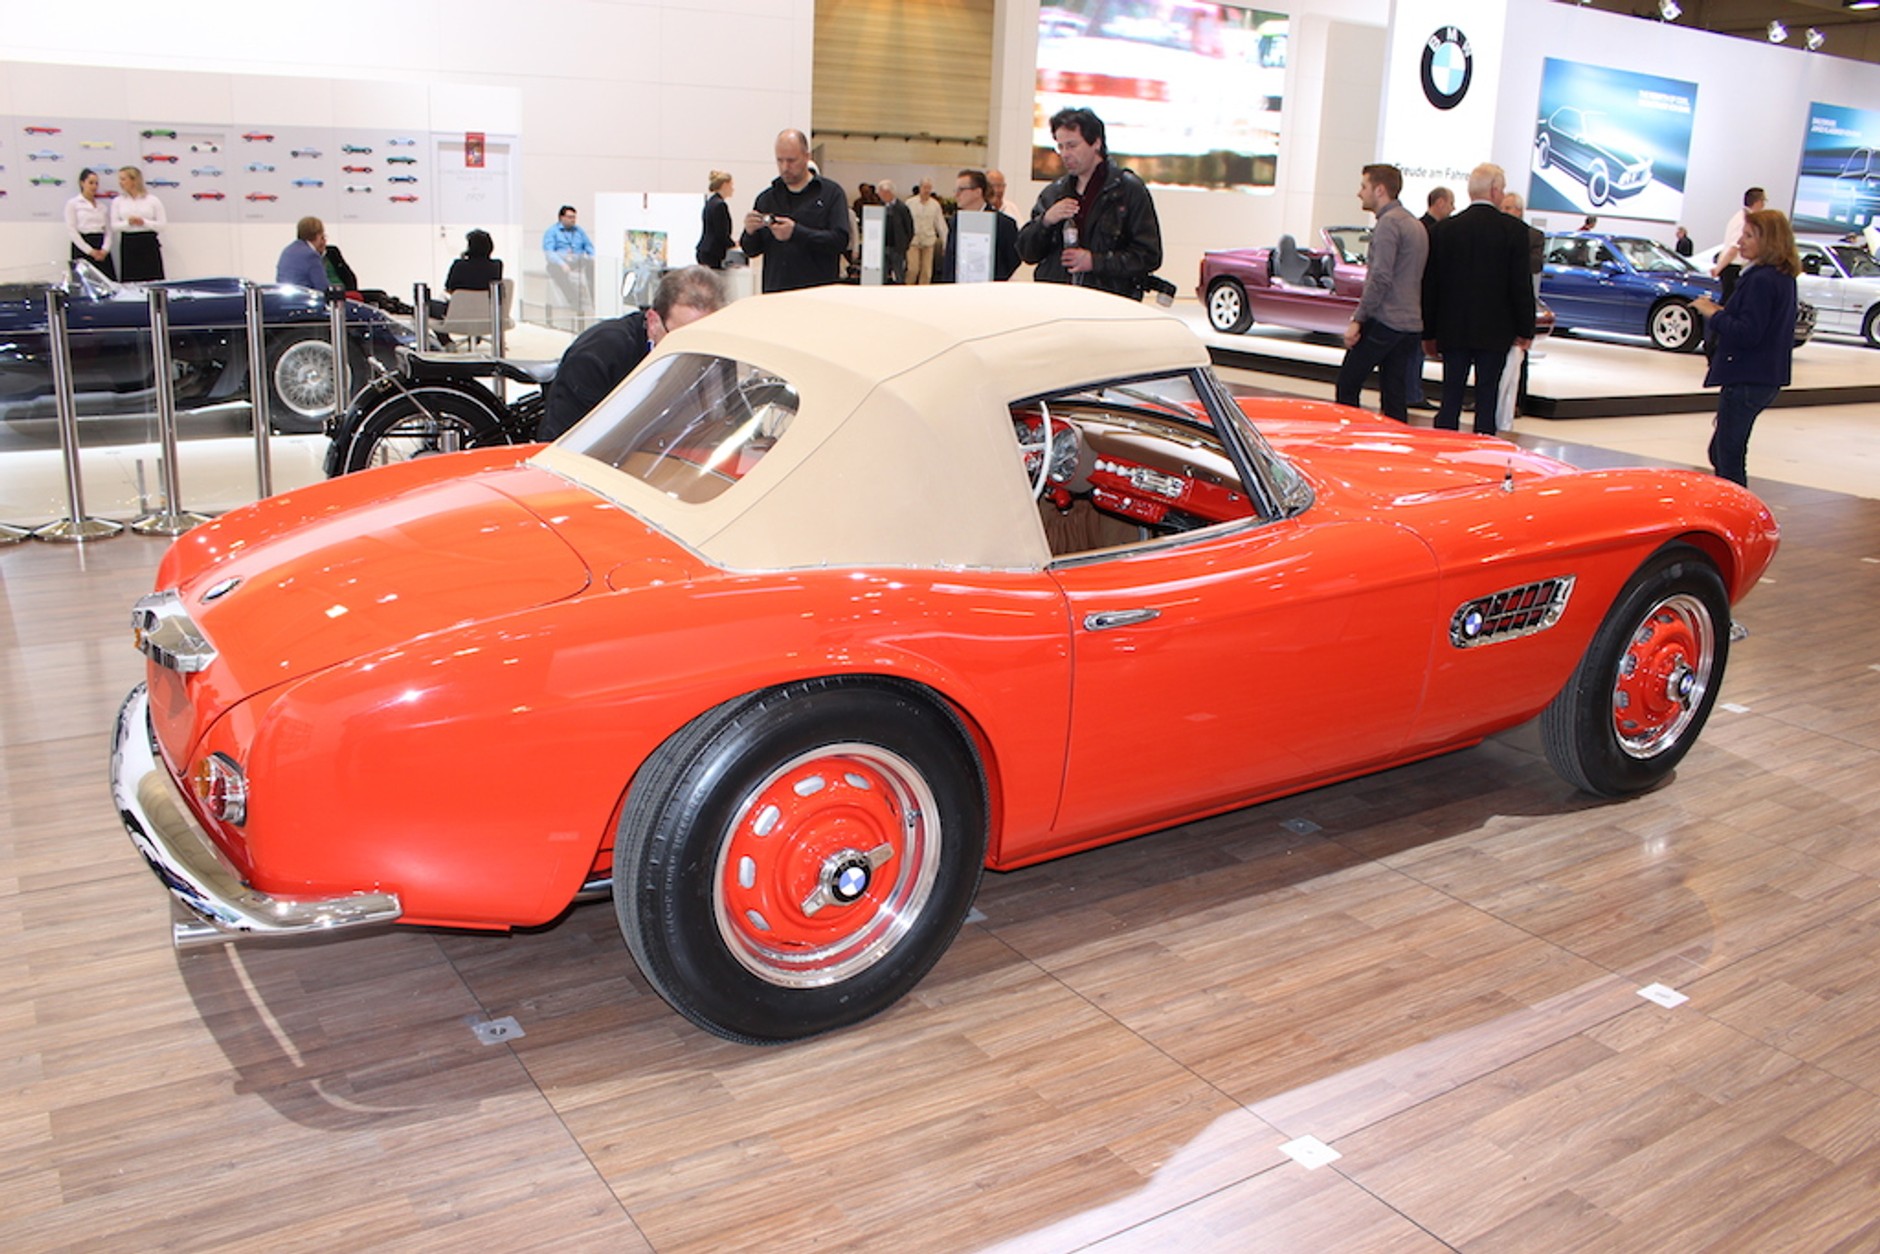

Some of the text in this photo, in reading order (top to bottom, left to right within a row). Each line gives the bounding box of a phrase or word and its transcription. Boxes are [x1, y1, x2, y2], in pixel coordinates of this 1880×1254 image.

[1427, 26, 1473, 58] BMW
[1430, 168, 1443, 179] am
[1446, 167, 1472, 181] Fahre
